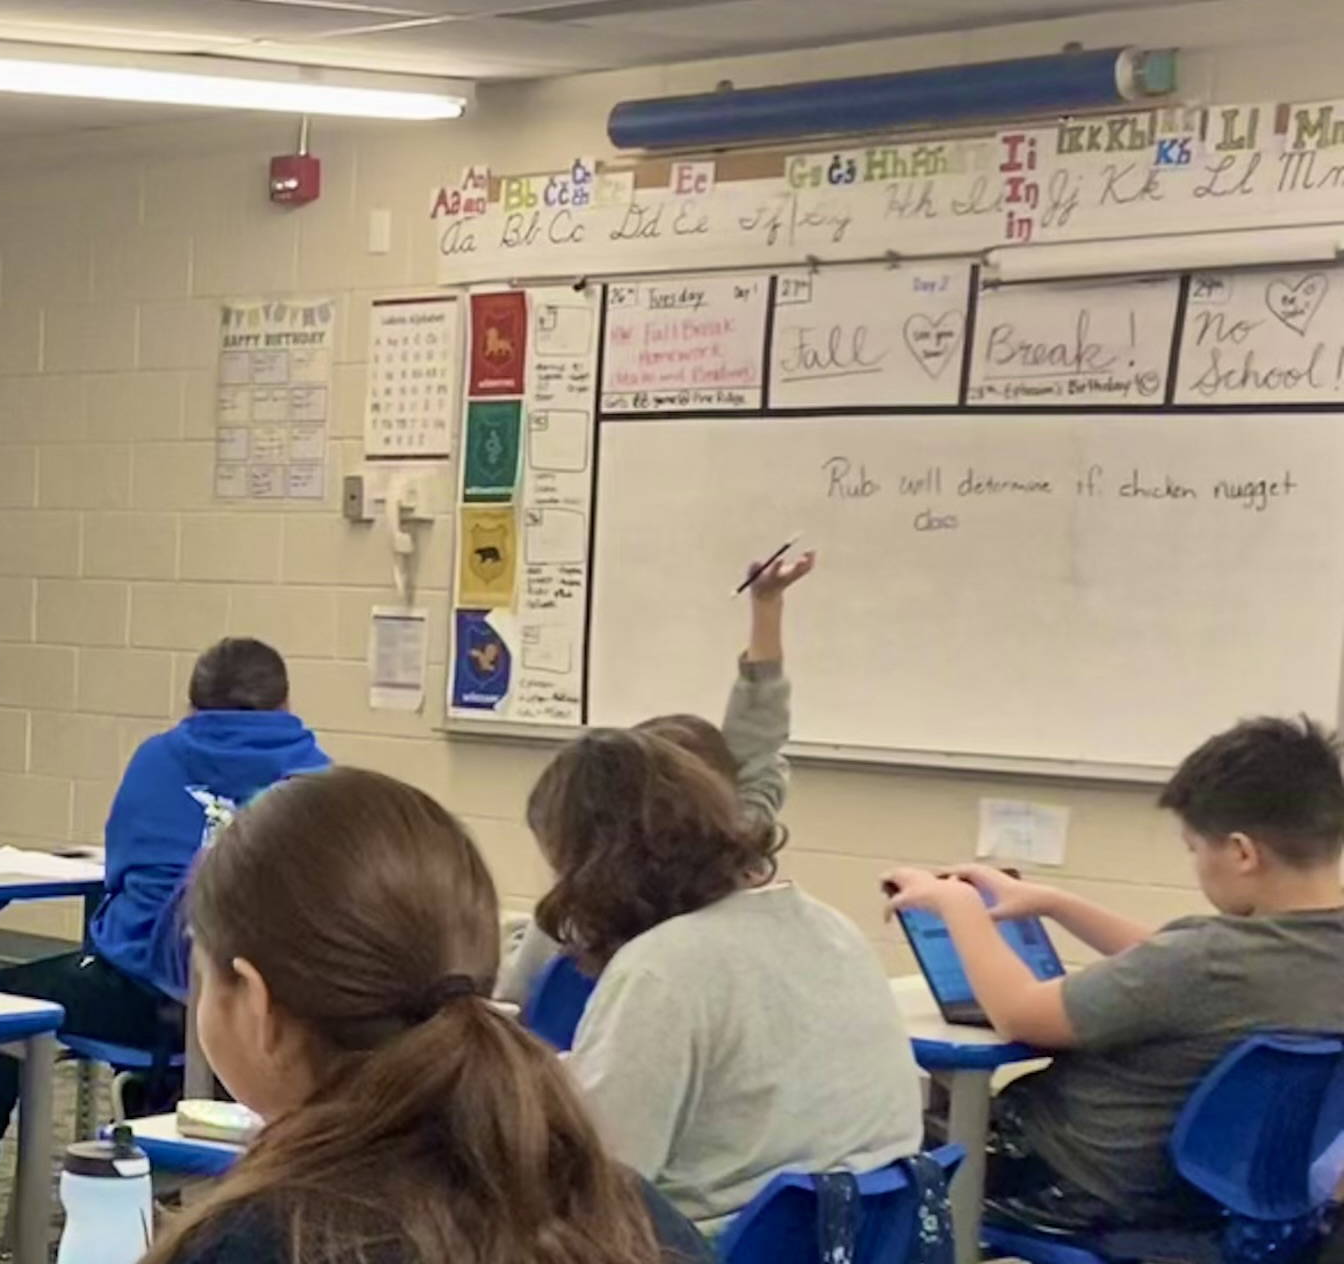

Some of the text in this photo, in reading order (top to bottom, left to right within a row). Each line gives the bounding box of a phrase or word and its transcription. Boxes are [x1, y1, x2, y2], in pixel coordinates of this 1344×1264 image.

[500, 213, 541, 248] Bb
[548, 208, 585, 244] Cc
[609, 203, 662, 240] Dd
[672, 199, 709, 235] Ee
[1193, 152, 1261, 199] Ll
[505, 179, 538, 210] Bb
[675, 165, 708, 194] Ee
[649, 287, 709, 312] Tuesday
[222, 331, 326, 349] HAPPY BIRTHDAY
[780, 324, 890, 372] Fall
[1195, 310, 1267, 346] No
[957, 466, 1054, 497] determine
[1120, 469, 1197, 501] chicken
[1214, 468, 1299, 512] nugget
